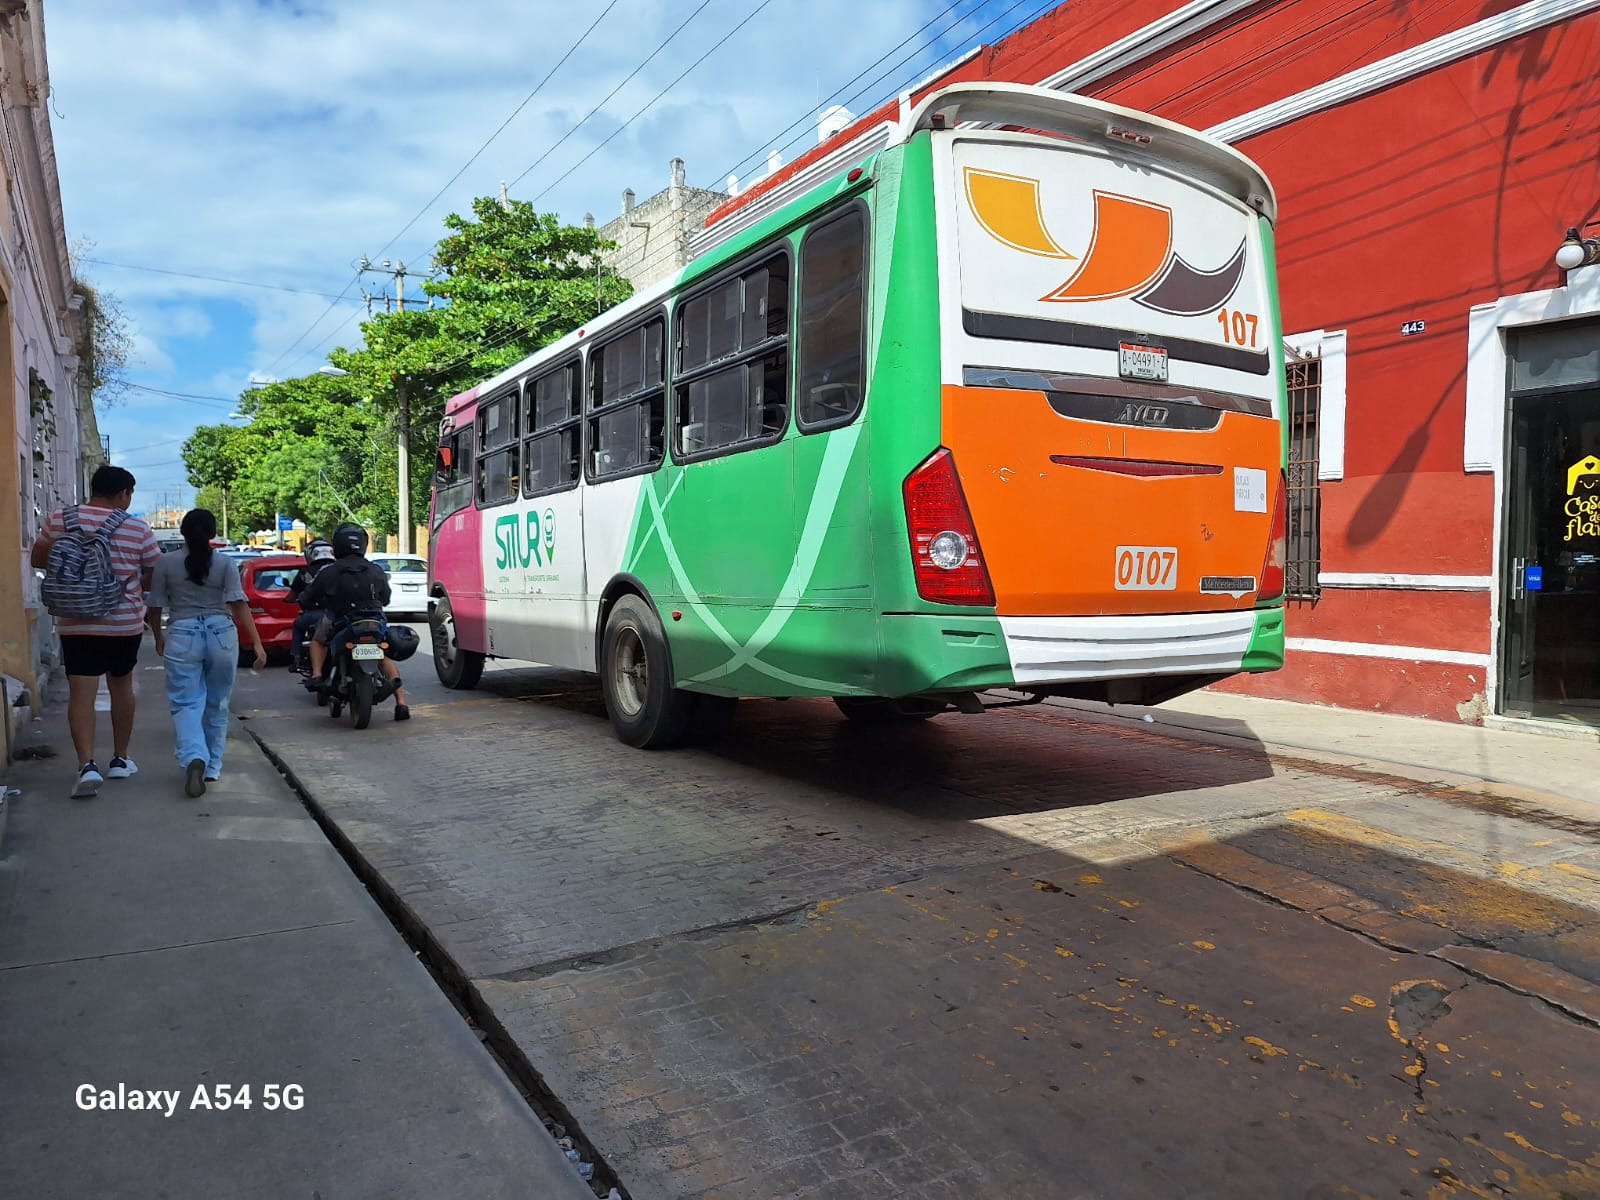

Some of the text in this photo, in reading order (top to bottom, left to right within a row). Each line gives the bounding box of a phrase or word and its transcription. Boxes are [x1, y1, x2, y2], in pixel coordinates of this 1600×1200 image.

[1217, 308, 1258, 348] 107
[1401, 321, 1425, 334] 443
[1564, 495, 1600, 517] Cas
[495, 510, 543, 570] SITUR
[1118, 550, 1176, 586] 0107
